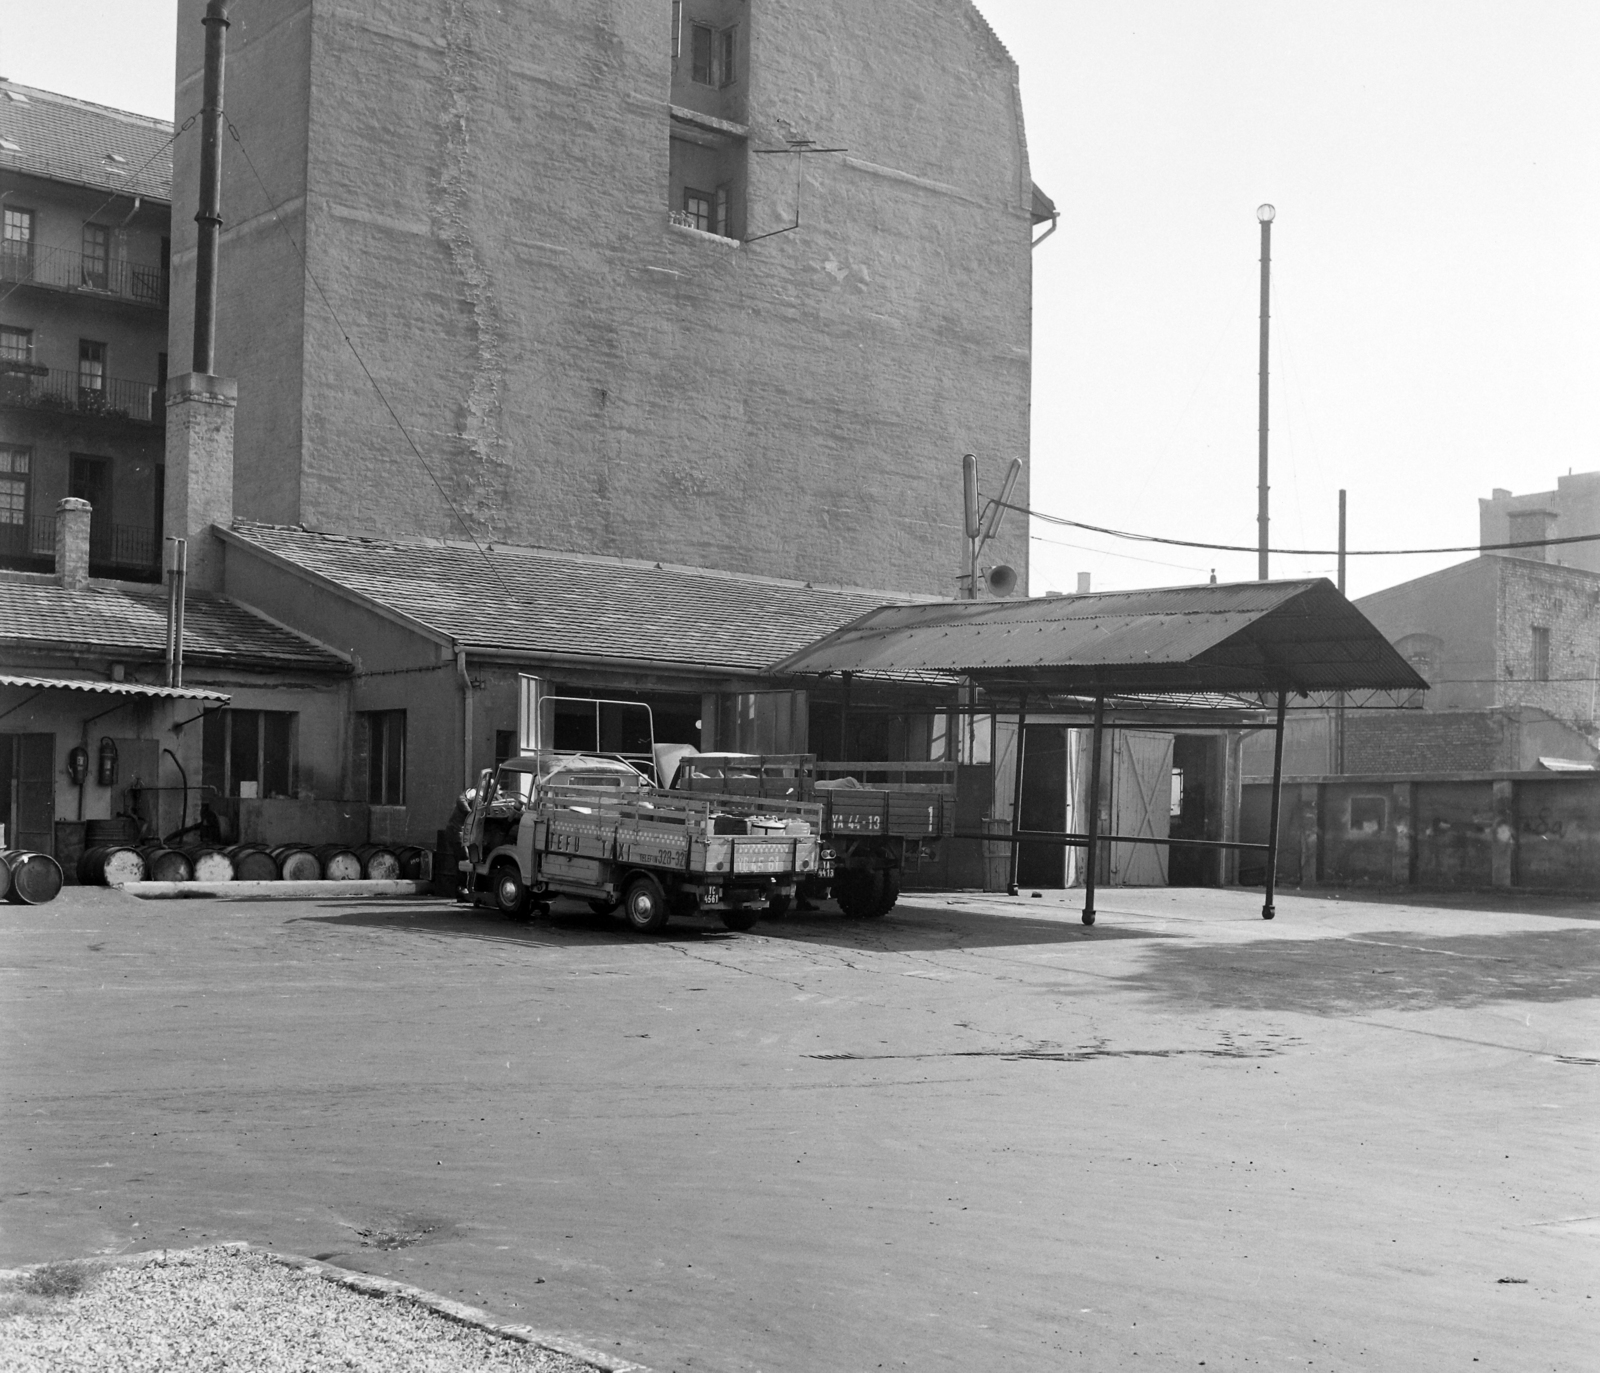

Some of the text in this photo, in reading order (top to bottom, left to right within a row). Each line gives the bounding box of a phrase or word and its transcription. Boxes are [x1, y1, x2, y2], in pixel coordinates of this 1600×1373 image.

[847, 814, 881, 830] 44-13
[550, 832, 580, 853] TEFU
[601, 840, 632, 862] TAXI
[704, 894, 719, 904] 4561
